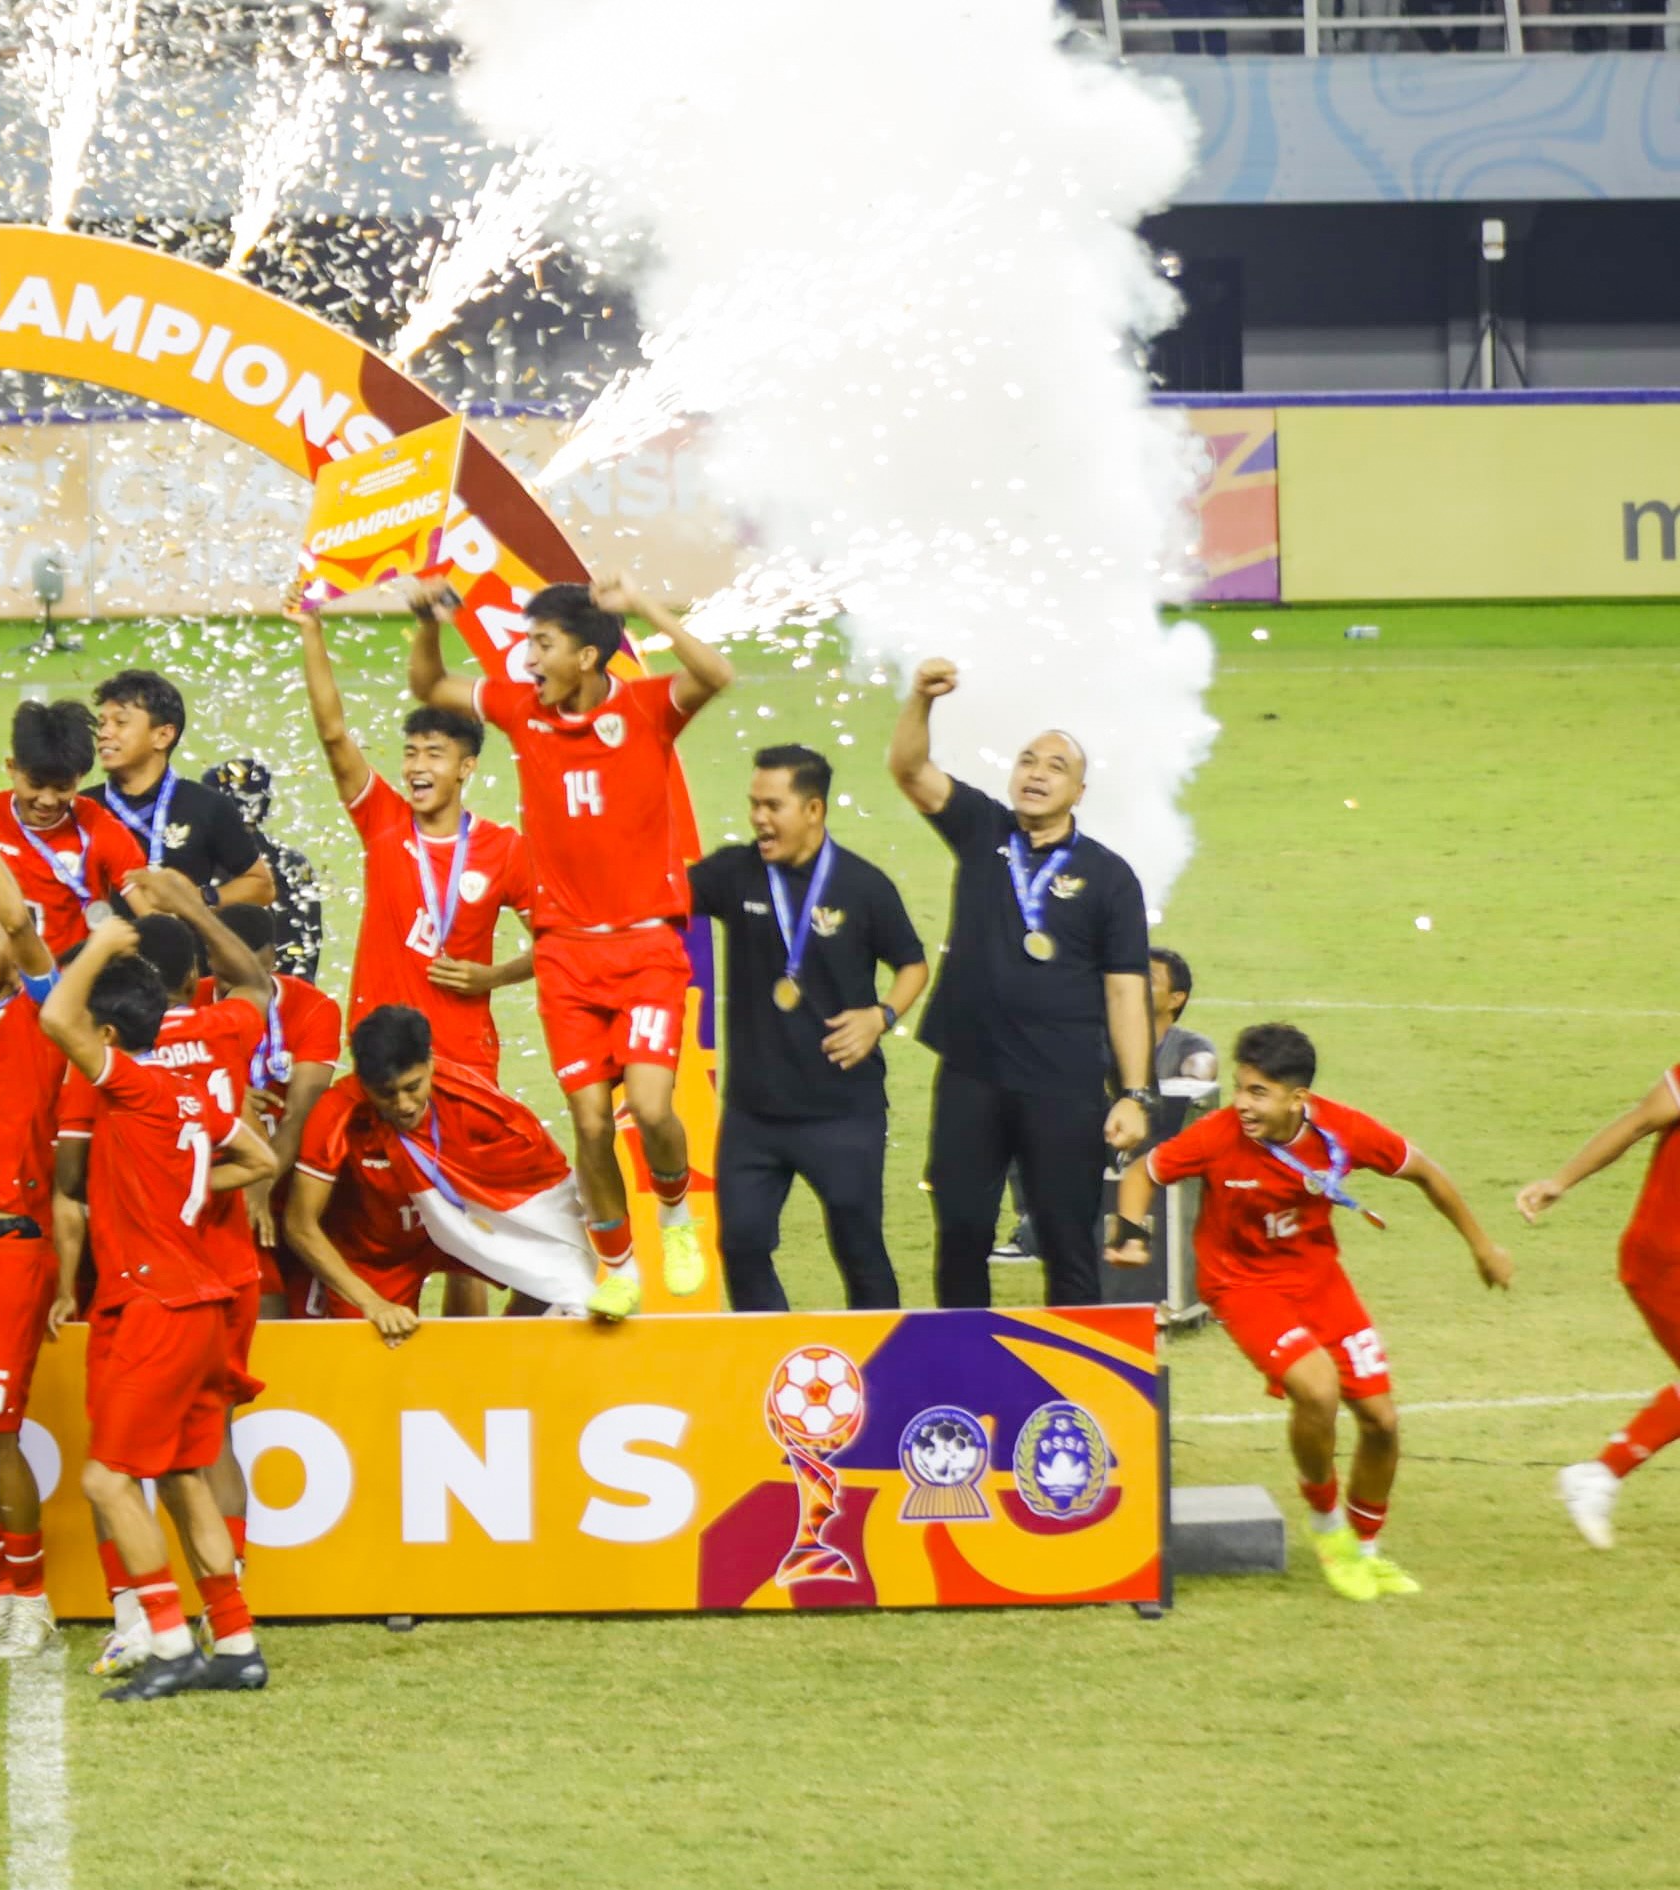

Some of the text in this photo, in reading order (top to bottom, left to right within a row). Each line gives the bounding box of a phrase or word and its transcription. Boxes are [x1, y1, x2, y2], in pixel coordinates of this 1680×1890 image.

[309, 490, 442, 553] CHAMPIONS
[563, 769, 604, 818] 14
[628, 1005, 670, 1052] 14
[1263, 1208, 1301, 1239] 12
[1341, 1327, 1391, 1388] 12
[1039, 1435, 1084, 1454] PSSI
